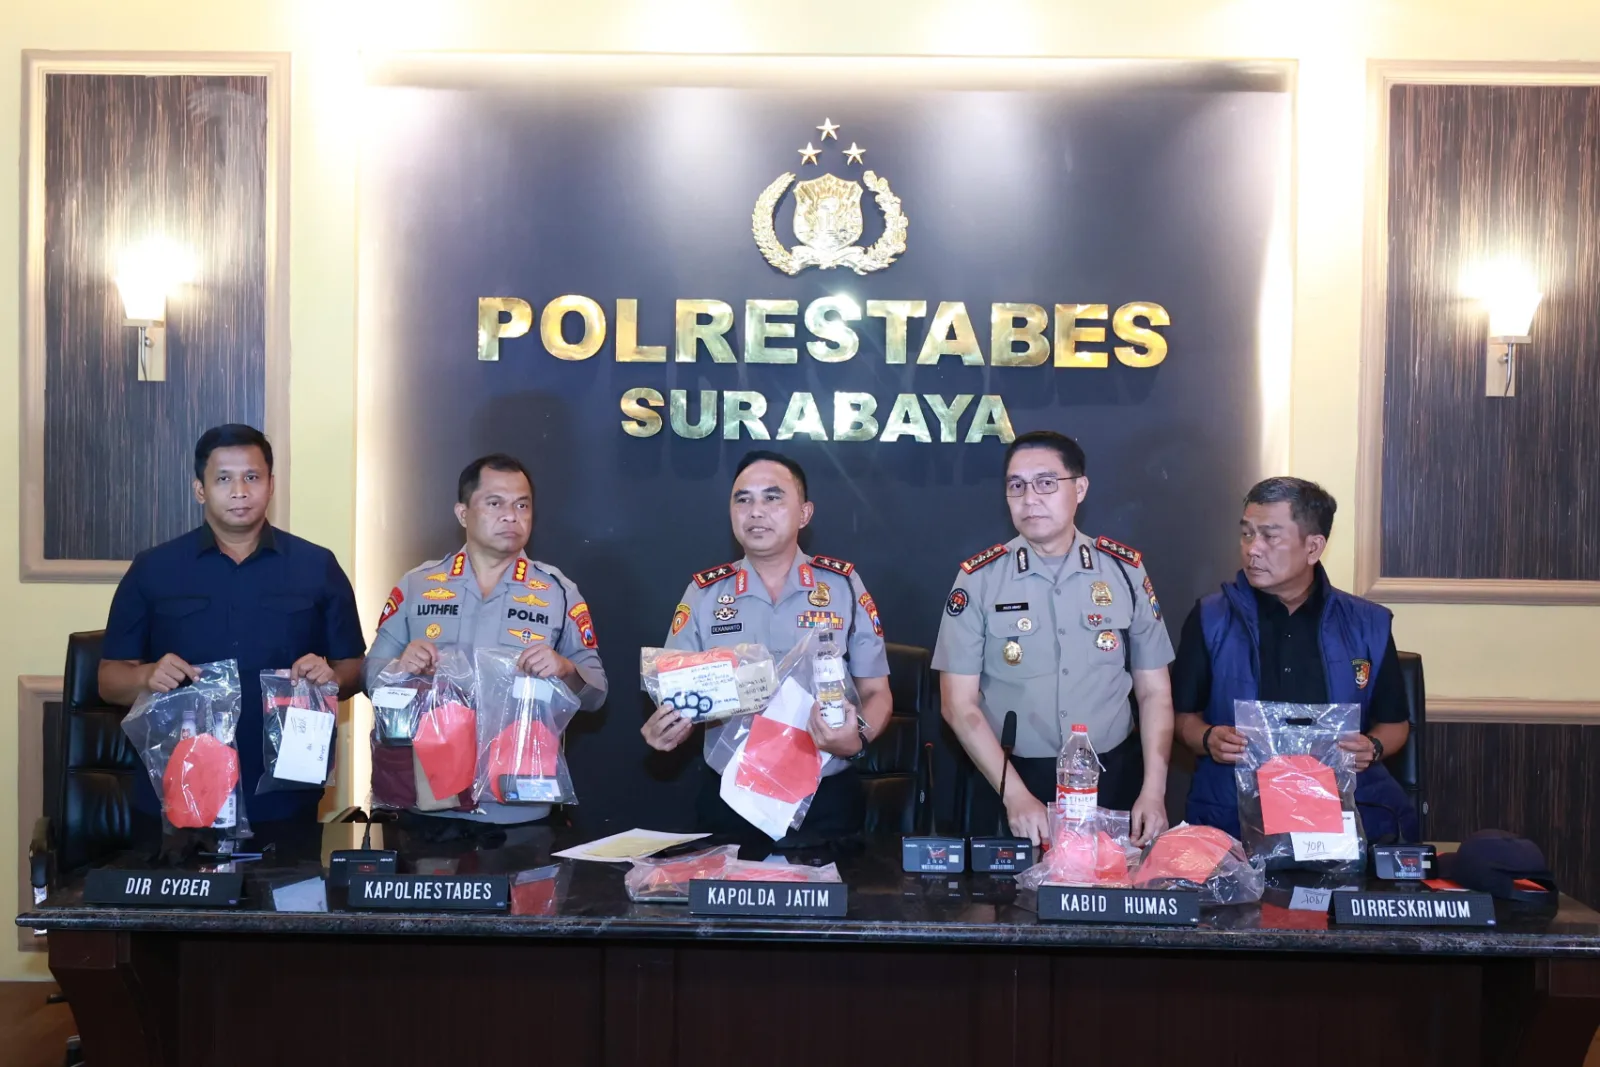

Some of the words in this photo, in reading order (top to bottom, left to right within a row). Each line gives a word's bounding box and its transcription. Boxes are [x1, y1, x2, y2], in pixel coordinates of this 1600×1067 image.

[477, 294, 1171, 369] POLRESTABES
[620, 387, 1016, 444] SURABAYA
[417, 604, 459, 616] LUTHFIE
[507, 608, 549, 625] POLRI
[125, 877, 151, 895] DIR
[160, 878, 210, 897] CYBER
[364, 881, 492, 900] KAPOLRESTABES
[707, 887, 776, 906] KAPOLDA
[785, 889, 829, 907] JATIM
[1060, 893, 1107, 912] KABID
[1124, 896, 1178, 916] HUMAS
[1350, 898, 1471, 918] DIRRESKRIMUM
